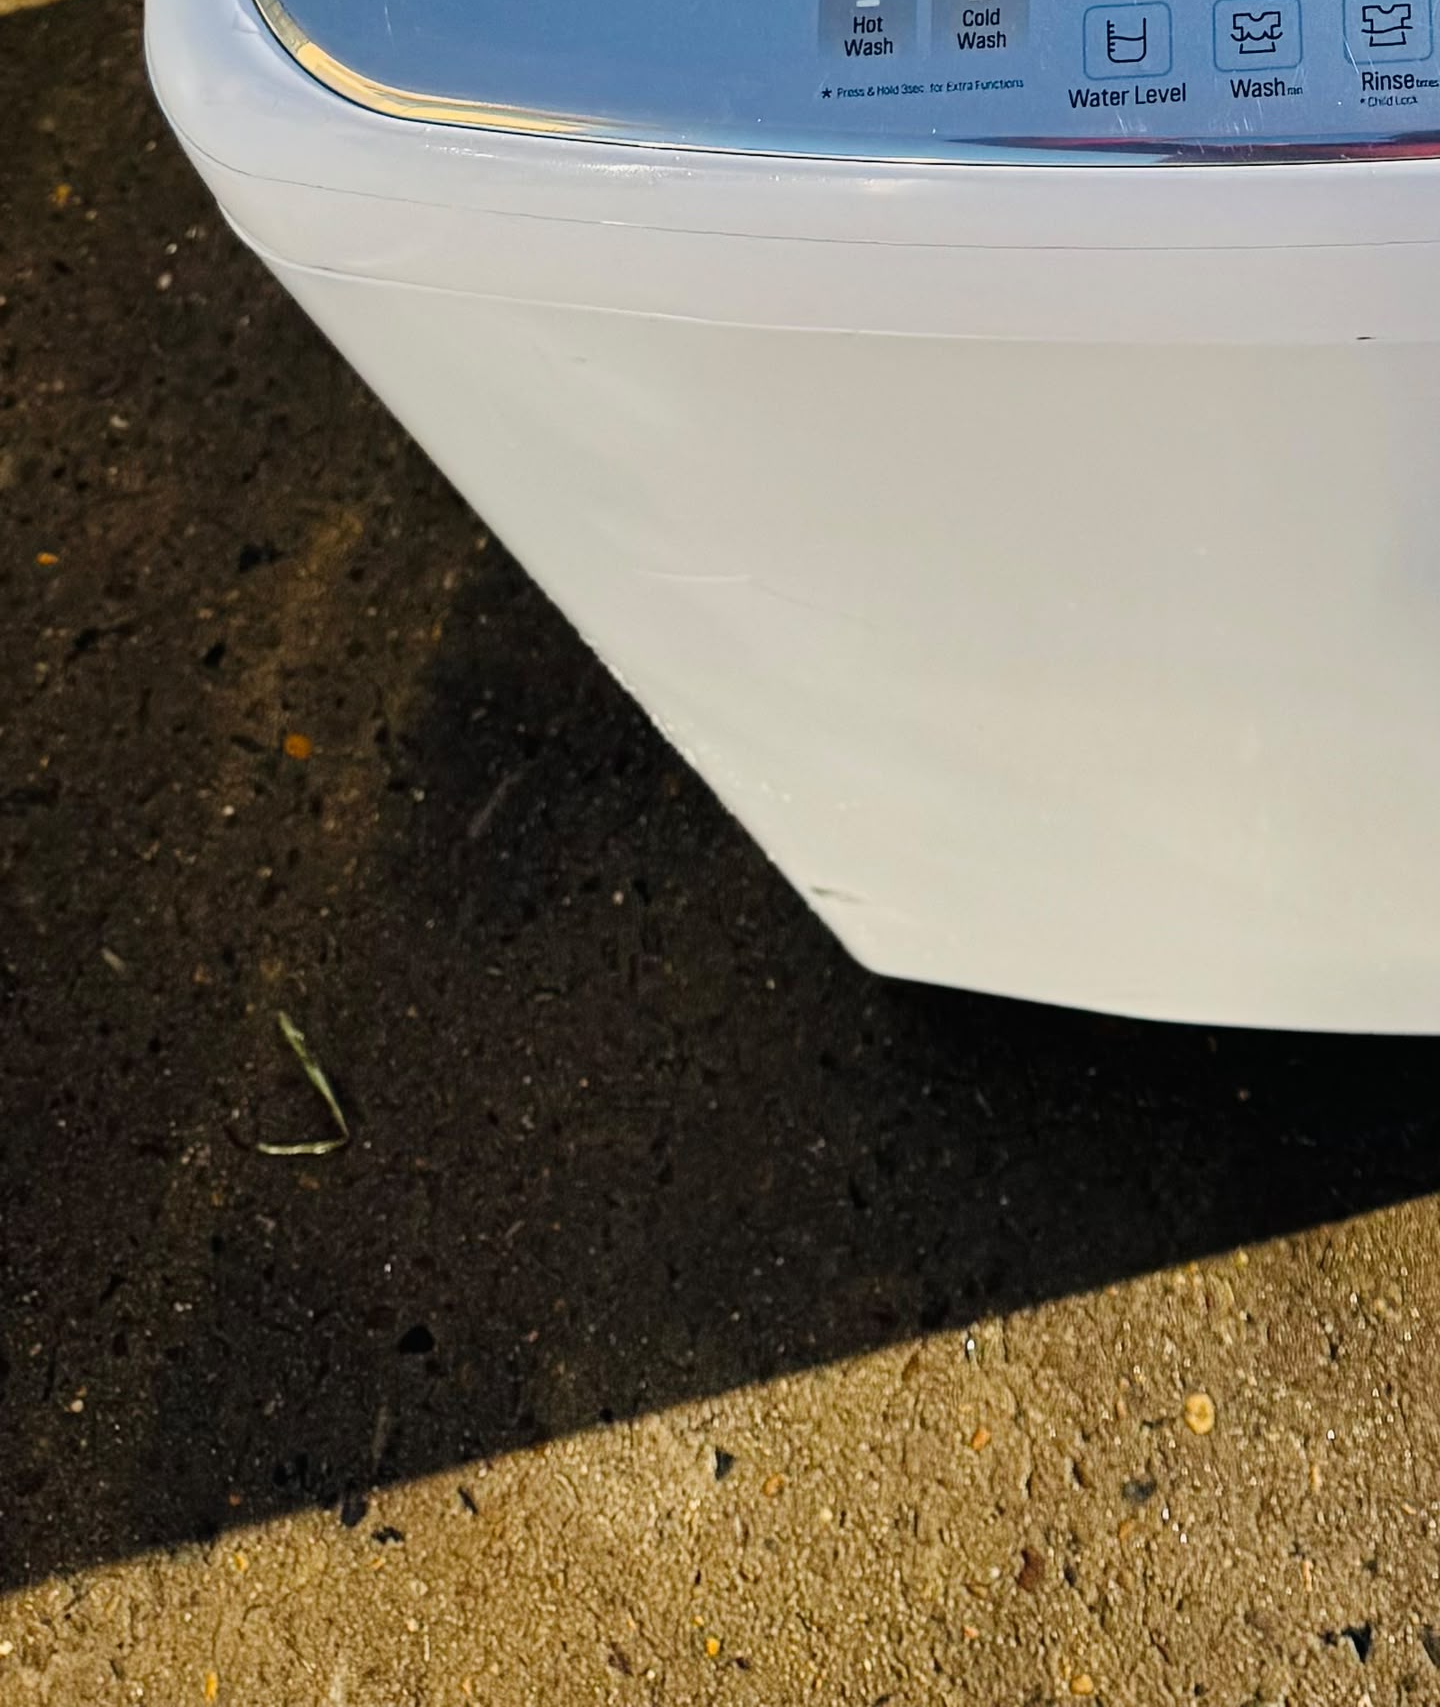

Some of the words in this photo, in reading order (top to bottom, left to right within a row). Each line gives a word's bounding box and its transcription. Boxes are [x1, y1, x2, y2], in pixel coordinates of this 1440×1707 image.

[853, 16, 884, 35] Hot
[962, 8, 1001, 28] Cold
[844, 38, 893, 58] Wash
[957, 31, 1006, 51] Wash
[837, 87, 864, 98] Press
[867, 86, 875, 96] &
[877, 85, 899, 96] Hold
[930, 83, 943, 93] for
[947, 81, 972, 92] Extra
[975, 78, 1024, 91] Functions
[1230, 78, 1286, 99] Wash
[1361, 71, 1414, 91] Rinse
[1069, 87, 1130, 108] Water
[1135, 83, 1187, 105] Level
